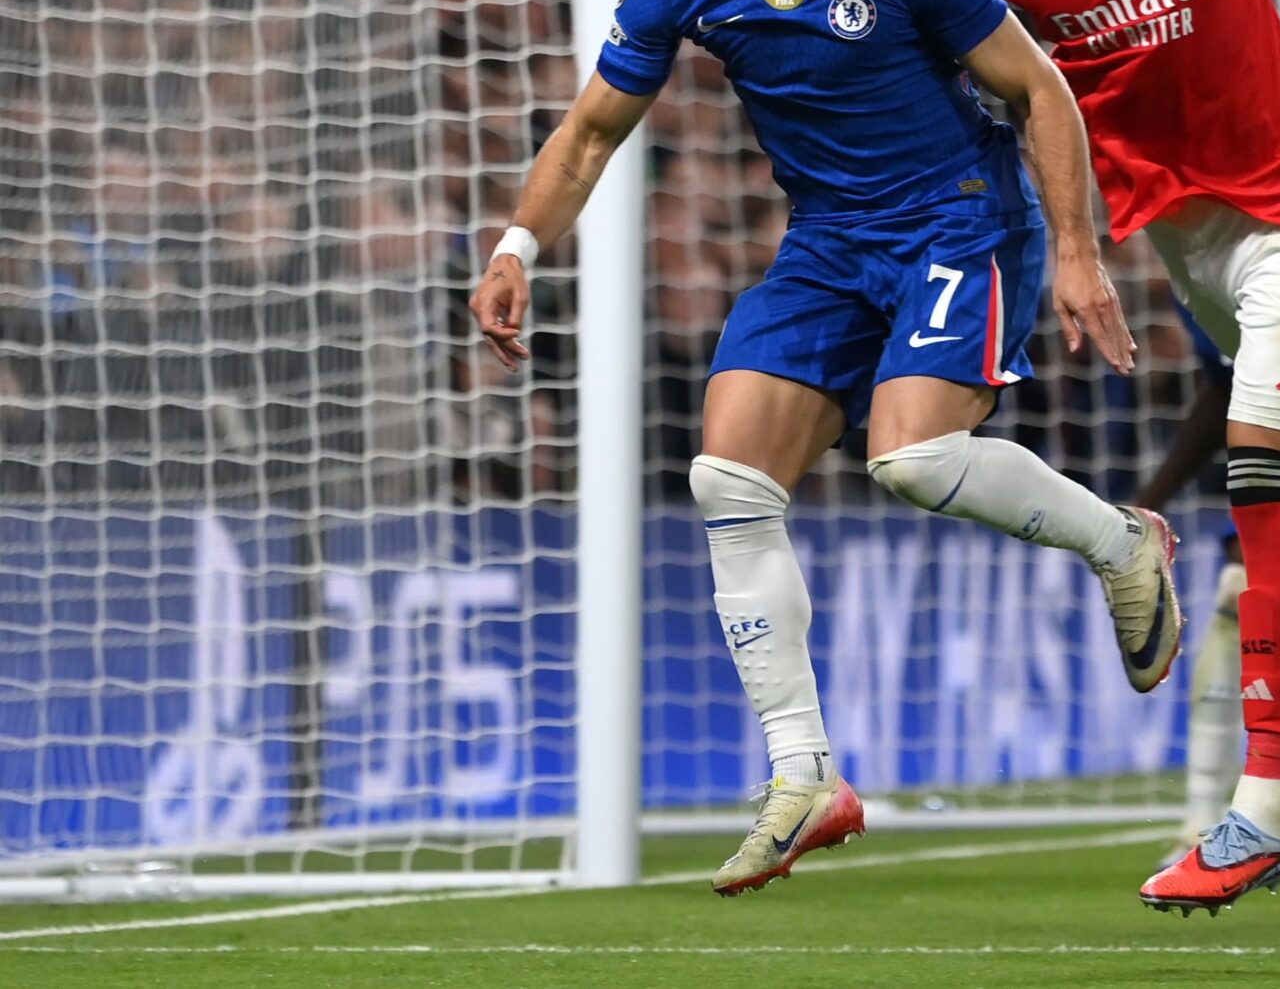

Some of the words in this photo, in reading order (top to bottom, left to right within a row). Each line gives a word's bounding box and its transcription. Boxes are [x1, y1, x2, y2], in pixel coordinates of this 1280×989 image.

[1123, 7, 1195, 48] BETTER
[927, 263, 964, 329] 7
[730, 618, 770, 635] CFC
